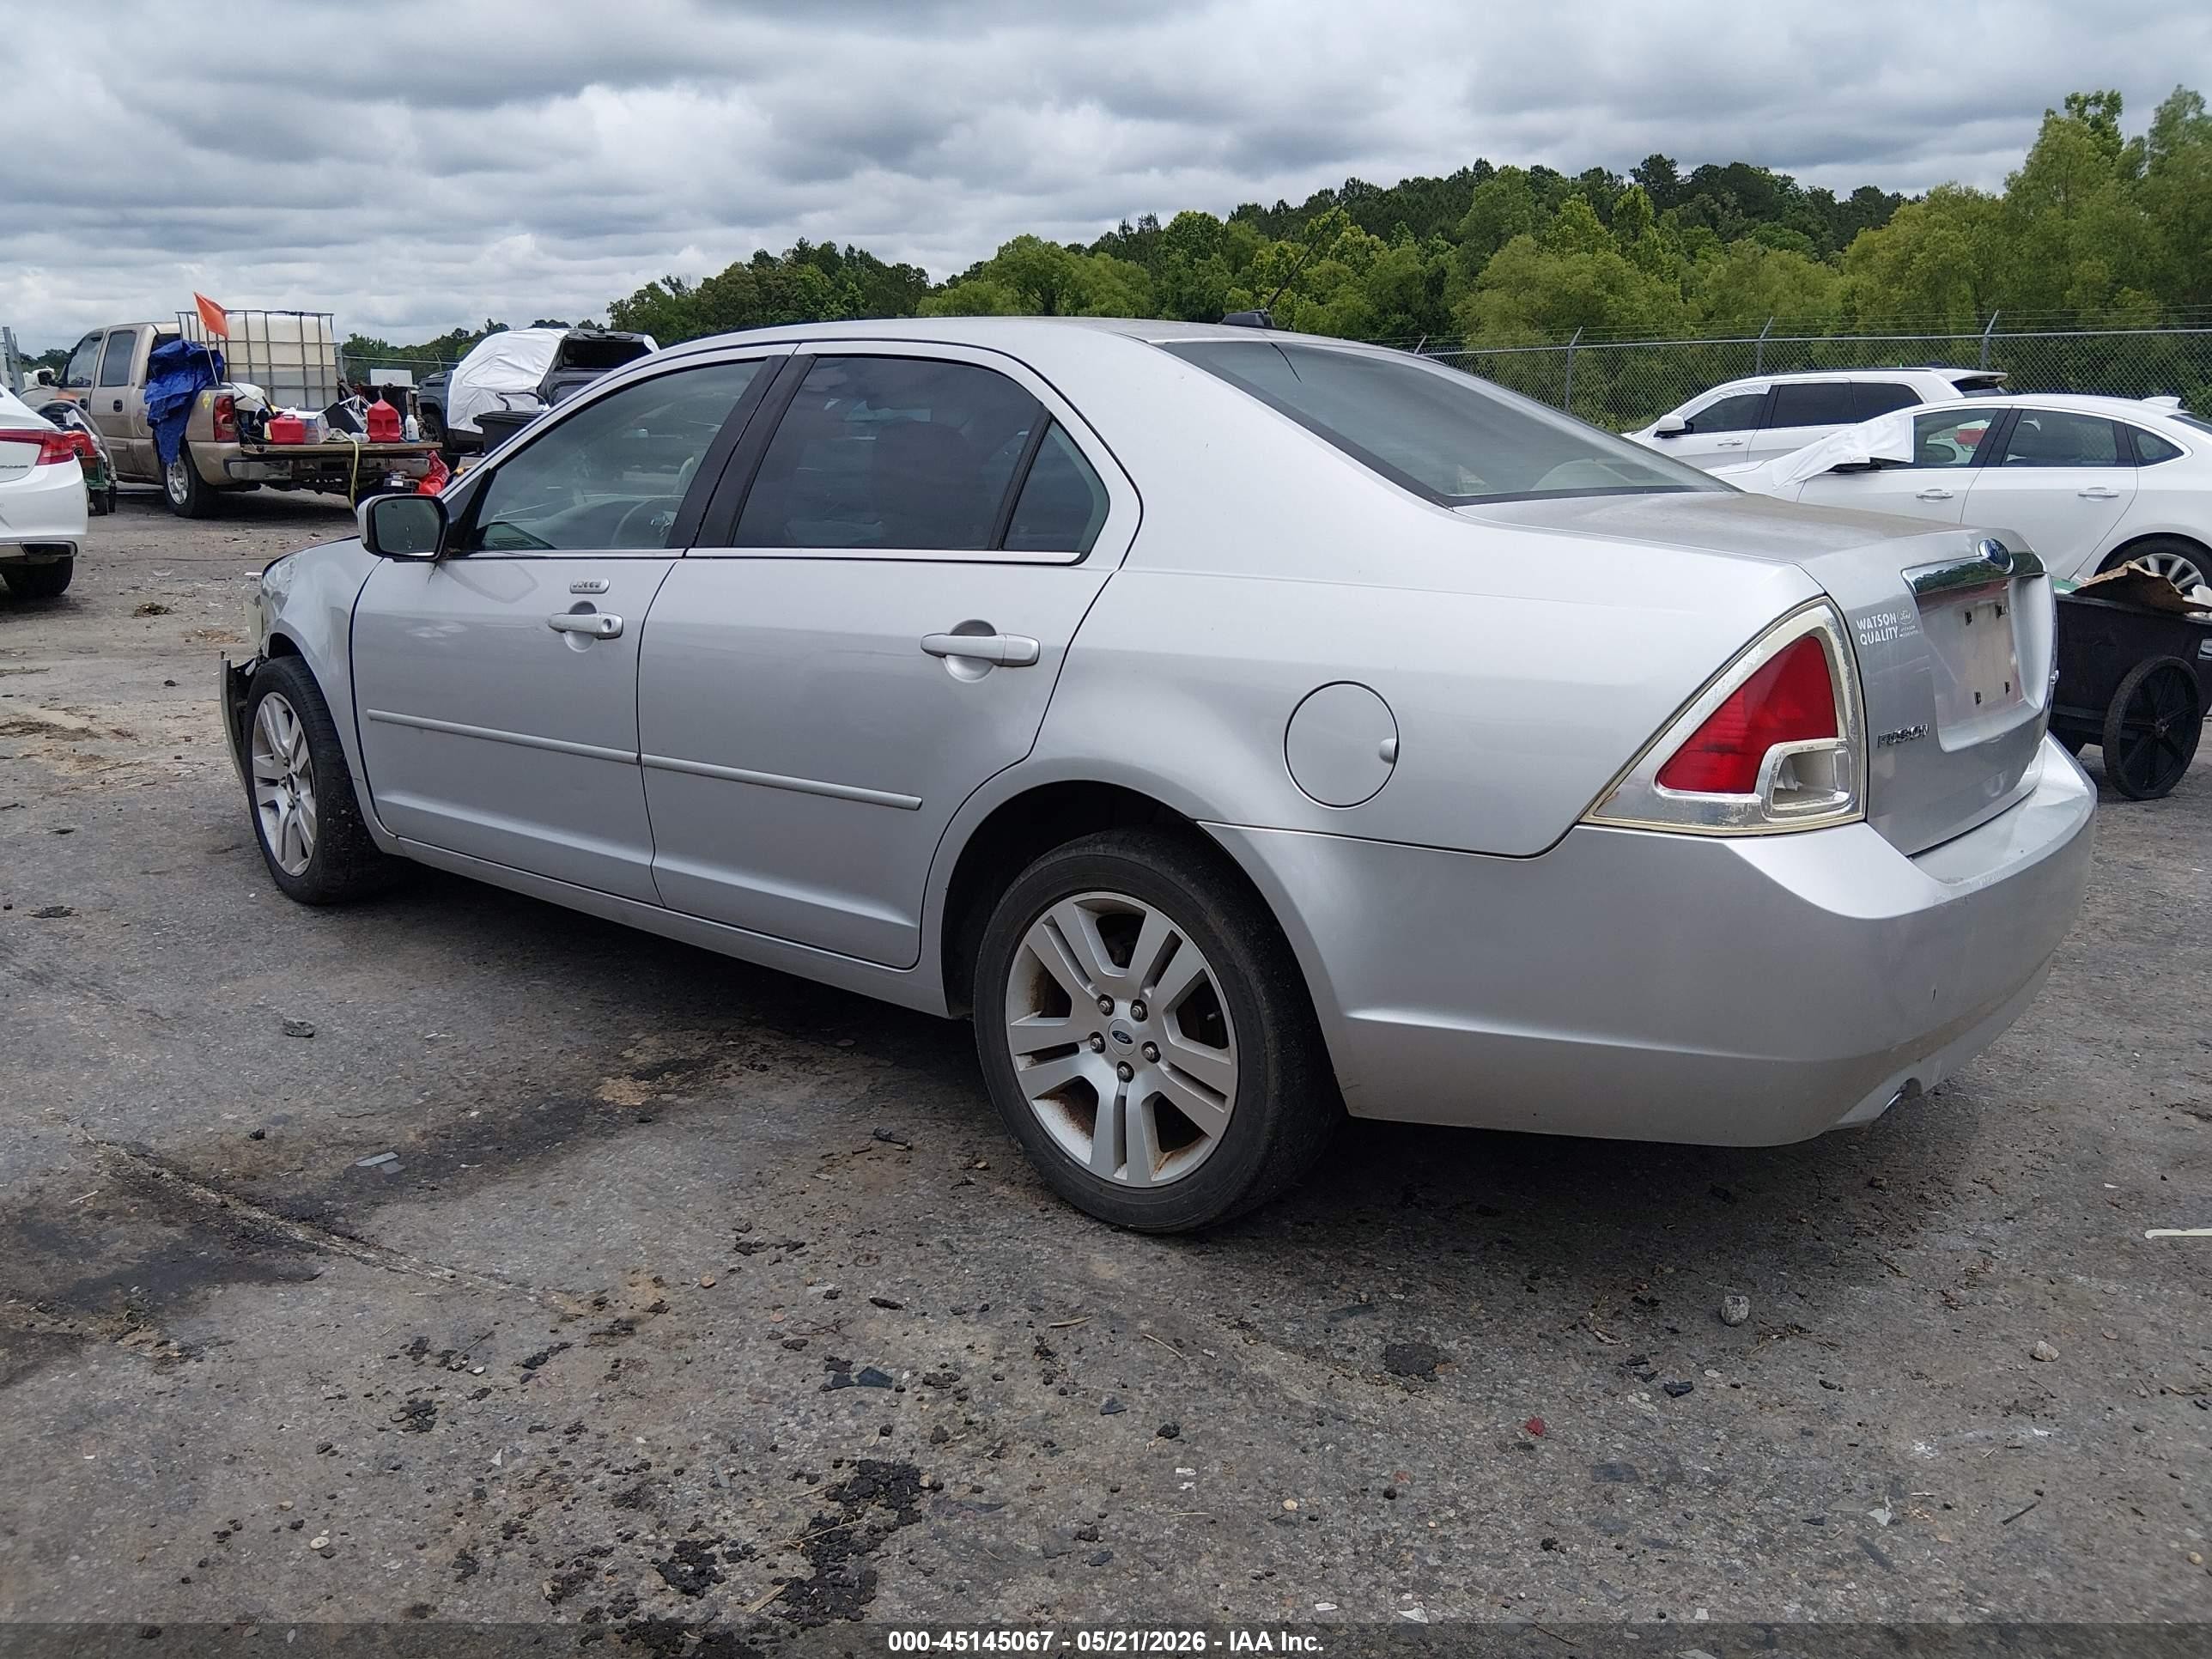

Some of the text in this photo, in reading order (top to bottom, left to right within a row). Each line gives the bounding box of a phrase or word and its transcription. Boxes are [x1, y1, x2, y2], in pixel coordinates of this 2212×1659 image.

[1856, 612, 1897, 630] WATSON
[1859, 625, 1899, 646] QUALITY
[1877, 723, 1929, 749] FUSION
